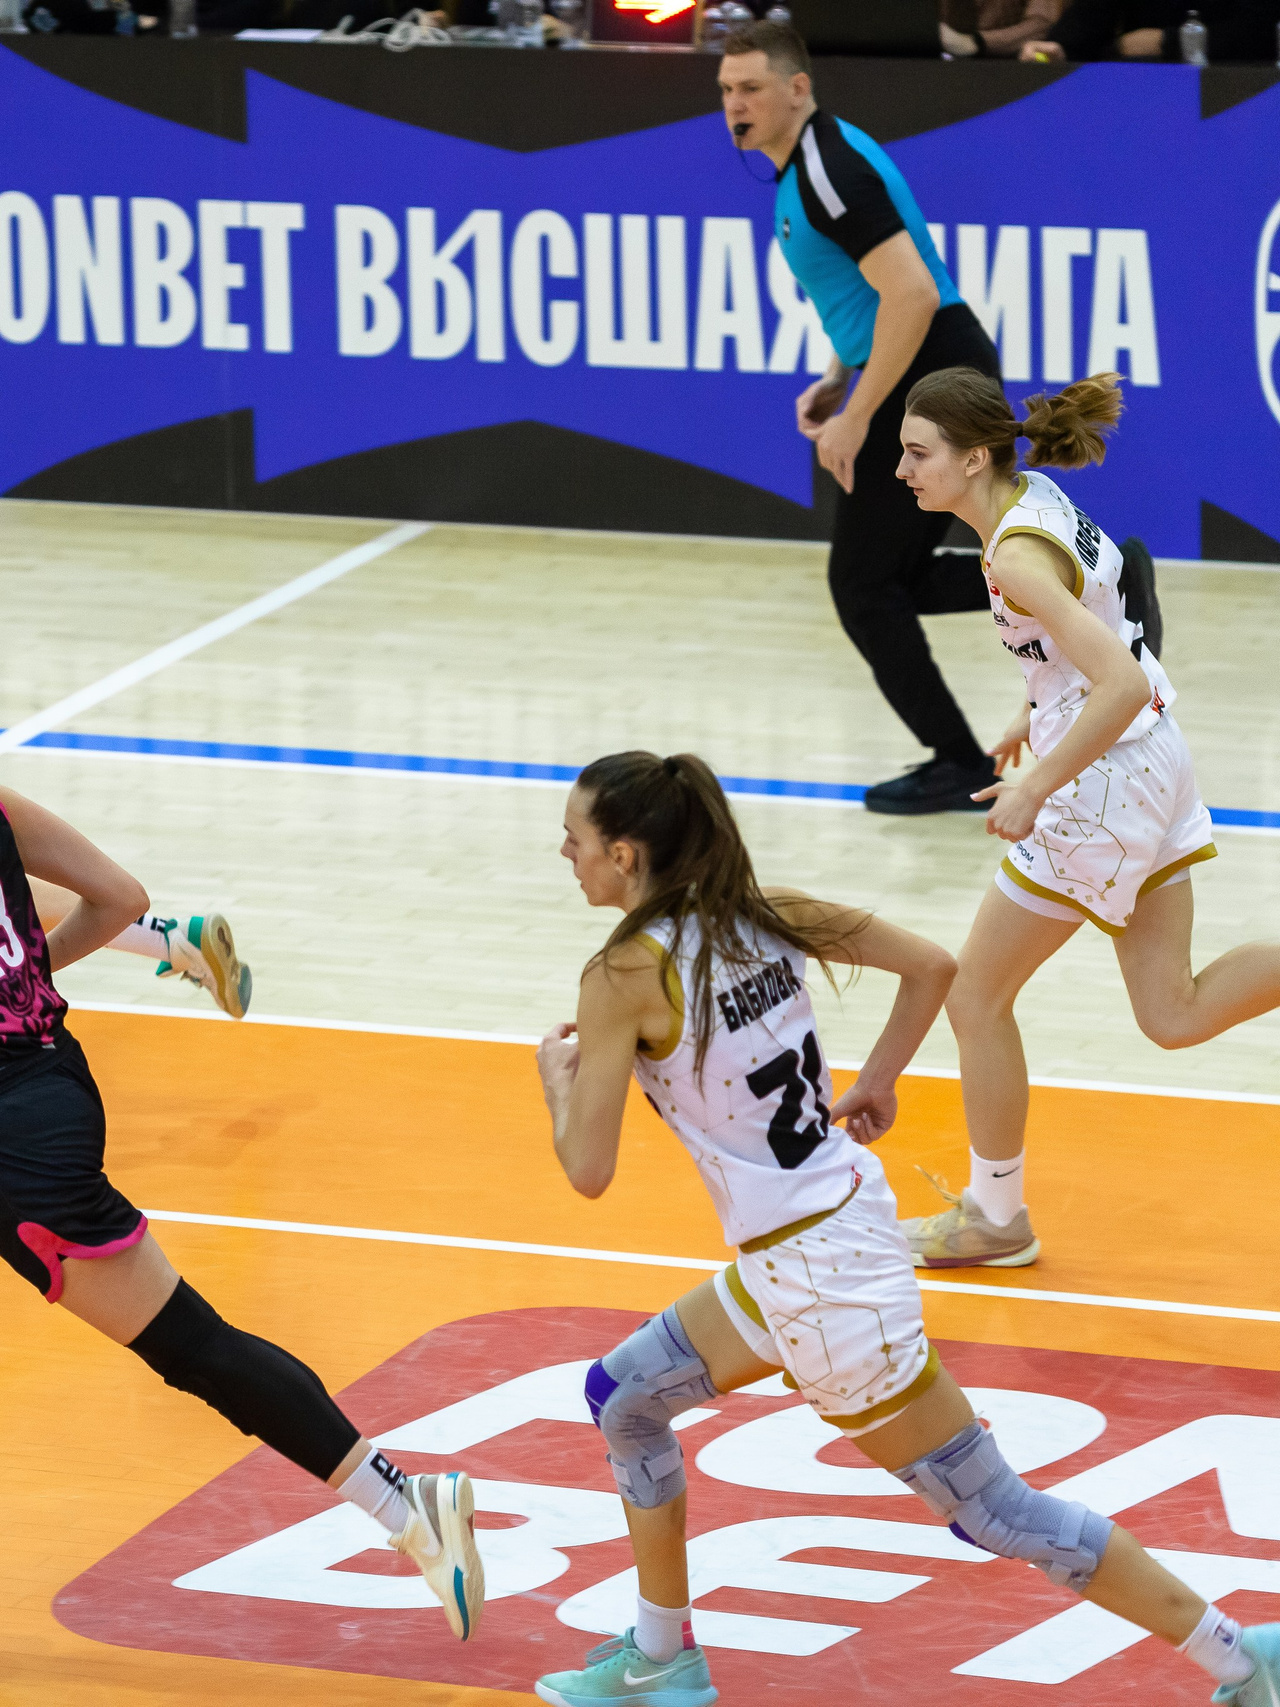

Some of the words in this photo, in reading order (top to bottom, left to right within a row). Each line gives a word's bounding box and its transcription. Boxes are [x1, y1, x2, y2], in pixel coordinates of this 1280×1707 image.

[335, 204, 832, 376] ВЫСШАЯ
[926, 223, 1160, 387] ИГА
[745, 1029, 831, 1170] 21
